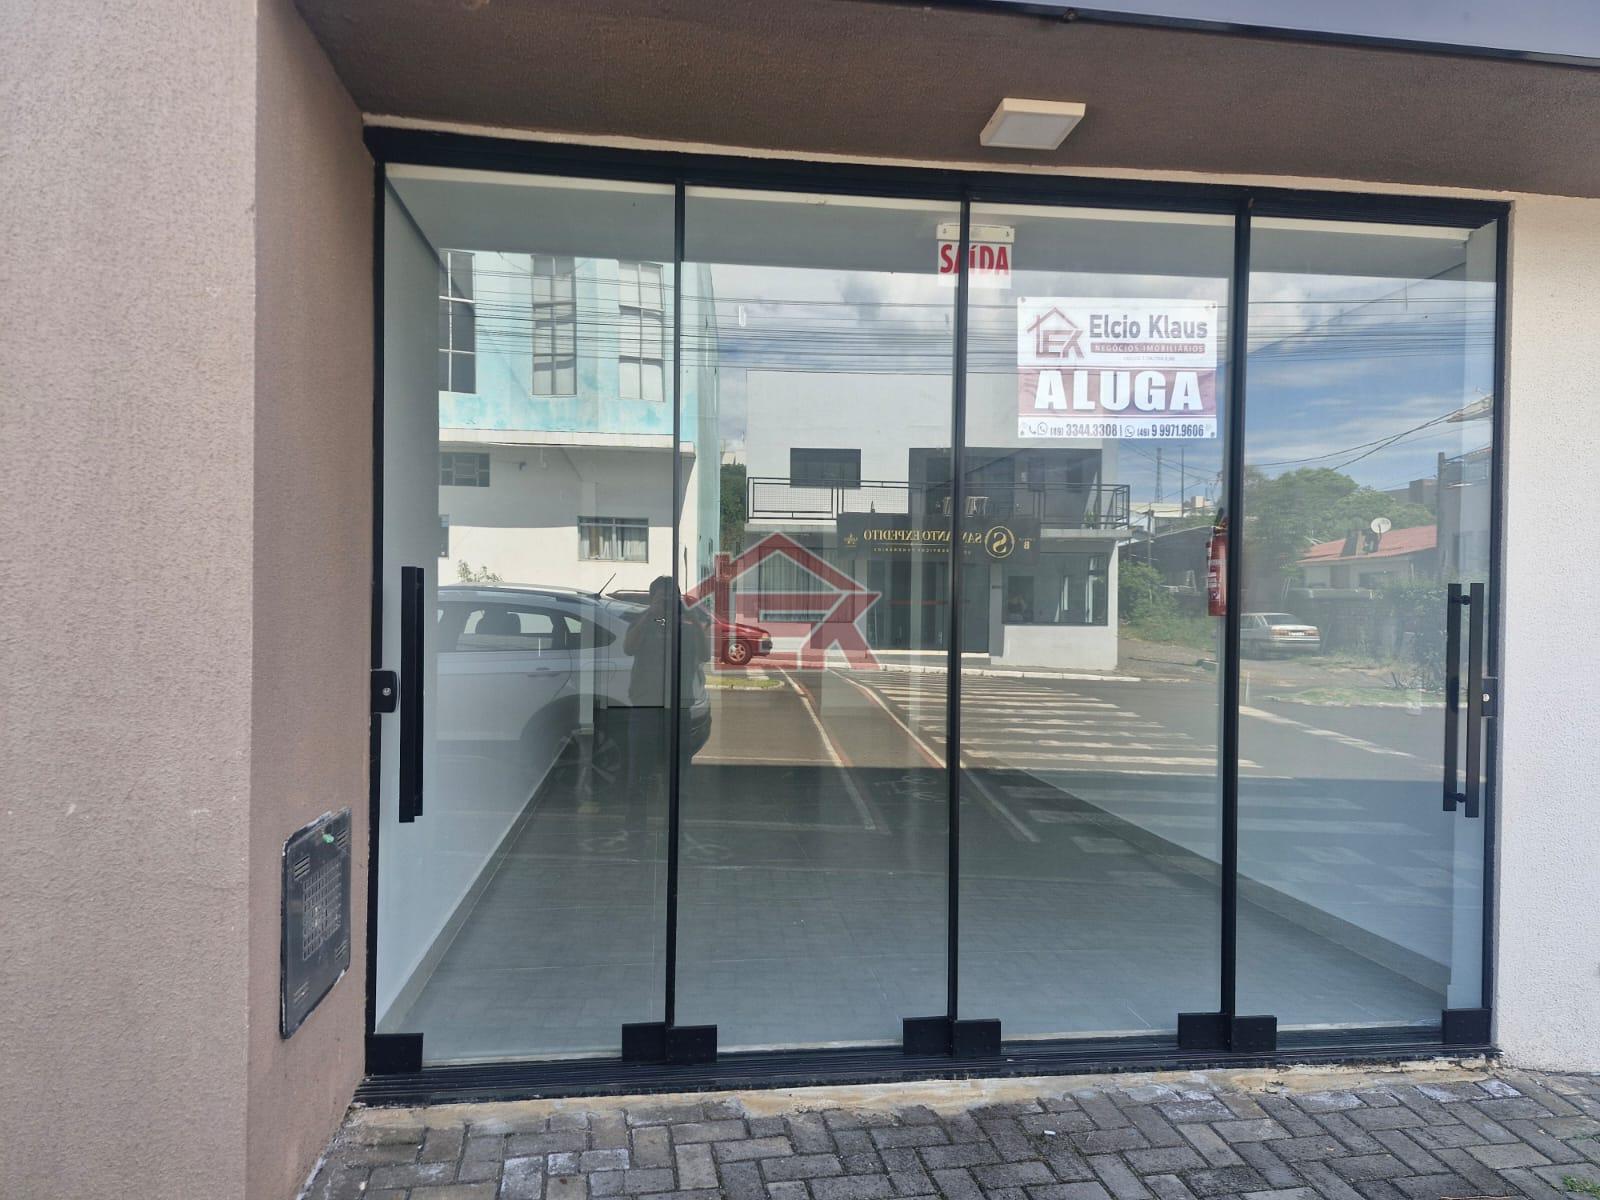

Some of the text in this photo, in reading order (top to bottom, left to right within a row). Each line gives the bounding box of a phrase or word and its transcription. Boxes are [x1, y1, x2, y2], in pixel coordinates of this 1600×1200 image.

[1089, 314, 1208, 339] Elcio Klaus
[1034, 370, 1203, 411] ALUGA
[1066, 424, 1118, 437] 3344.3308
